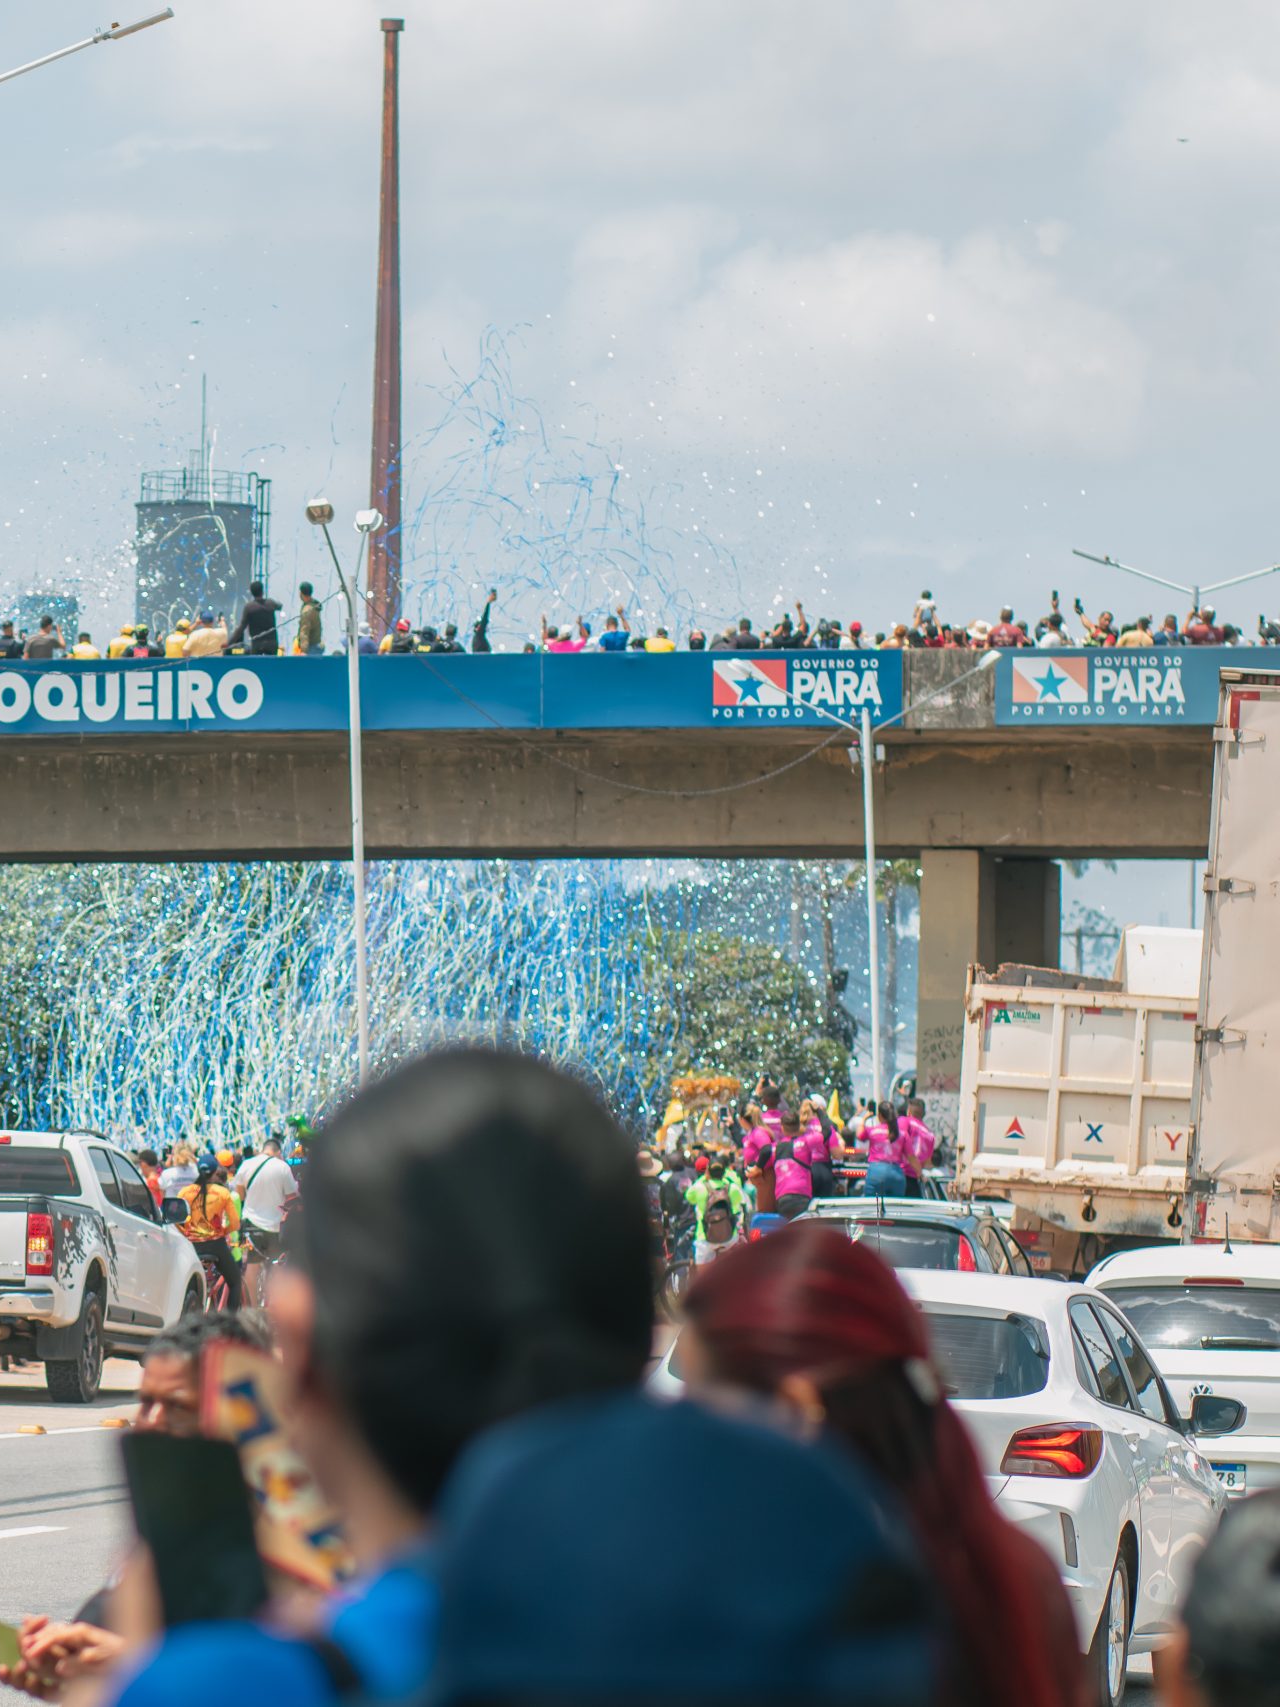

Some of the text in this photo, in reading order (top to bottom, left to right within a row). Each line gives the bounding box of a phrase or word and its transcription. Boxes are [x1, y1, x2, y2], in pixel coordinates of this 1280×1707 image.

[793, 658, 879, 669] GOVERNO DO
[1094, 656, 1182, 667] GOVERNO DO
[712, 708, 745, 718] POR
[757, 707, 803, 719] TODO
[1012, 705, 1045, 716] POR
[1057, 705, 1105, 716] TODO
[1118, 705, 1127, 716] O
[1084, 1122, 1182, 1151] X Y
